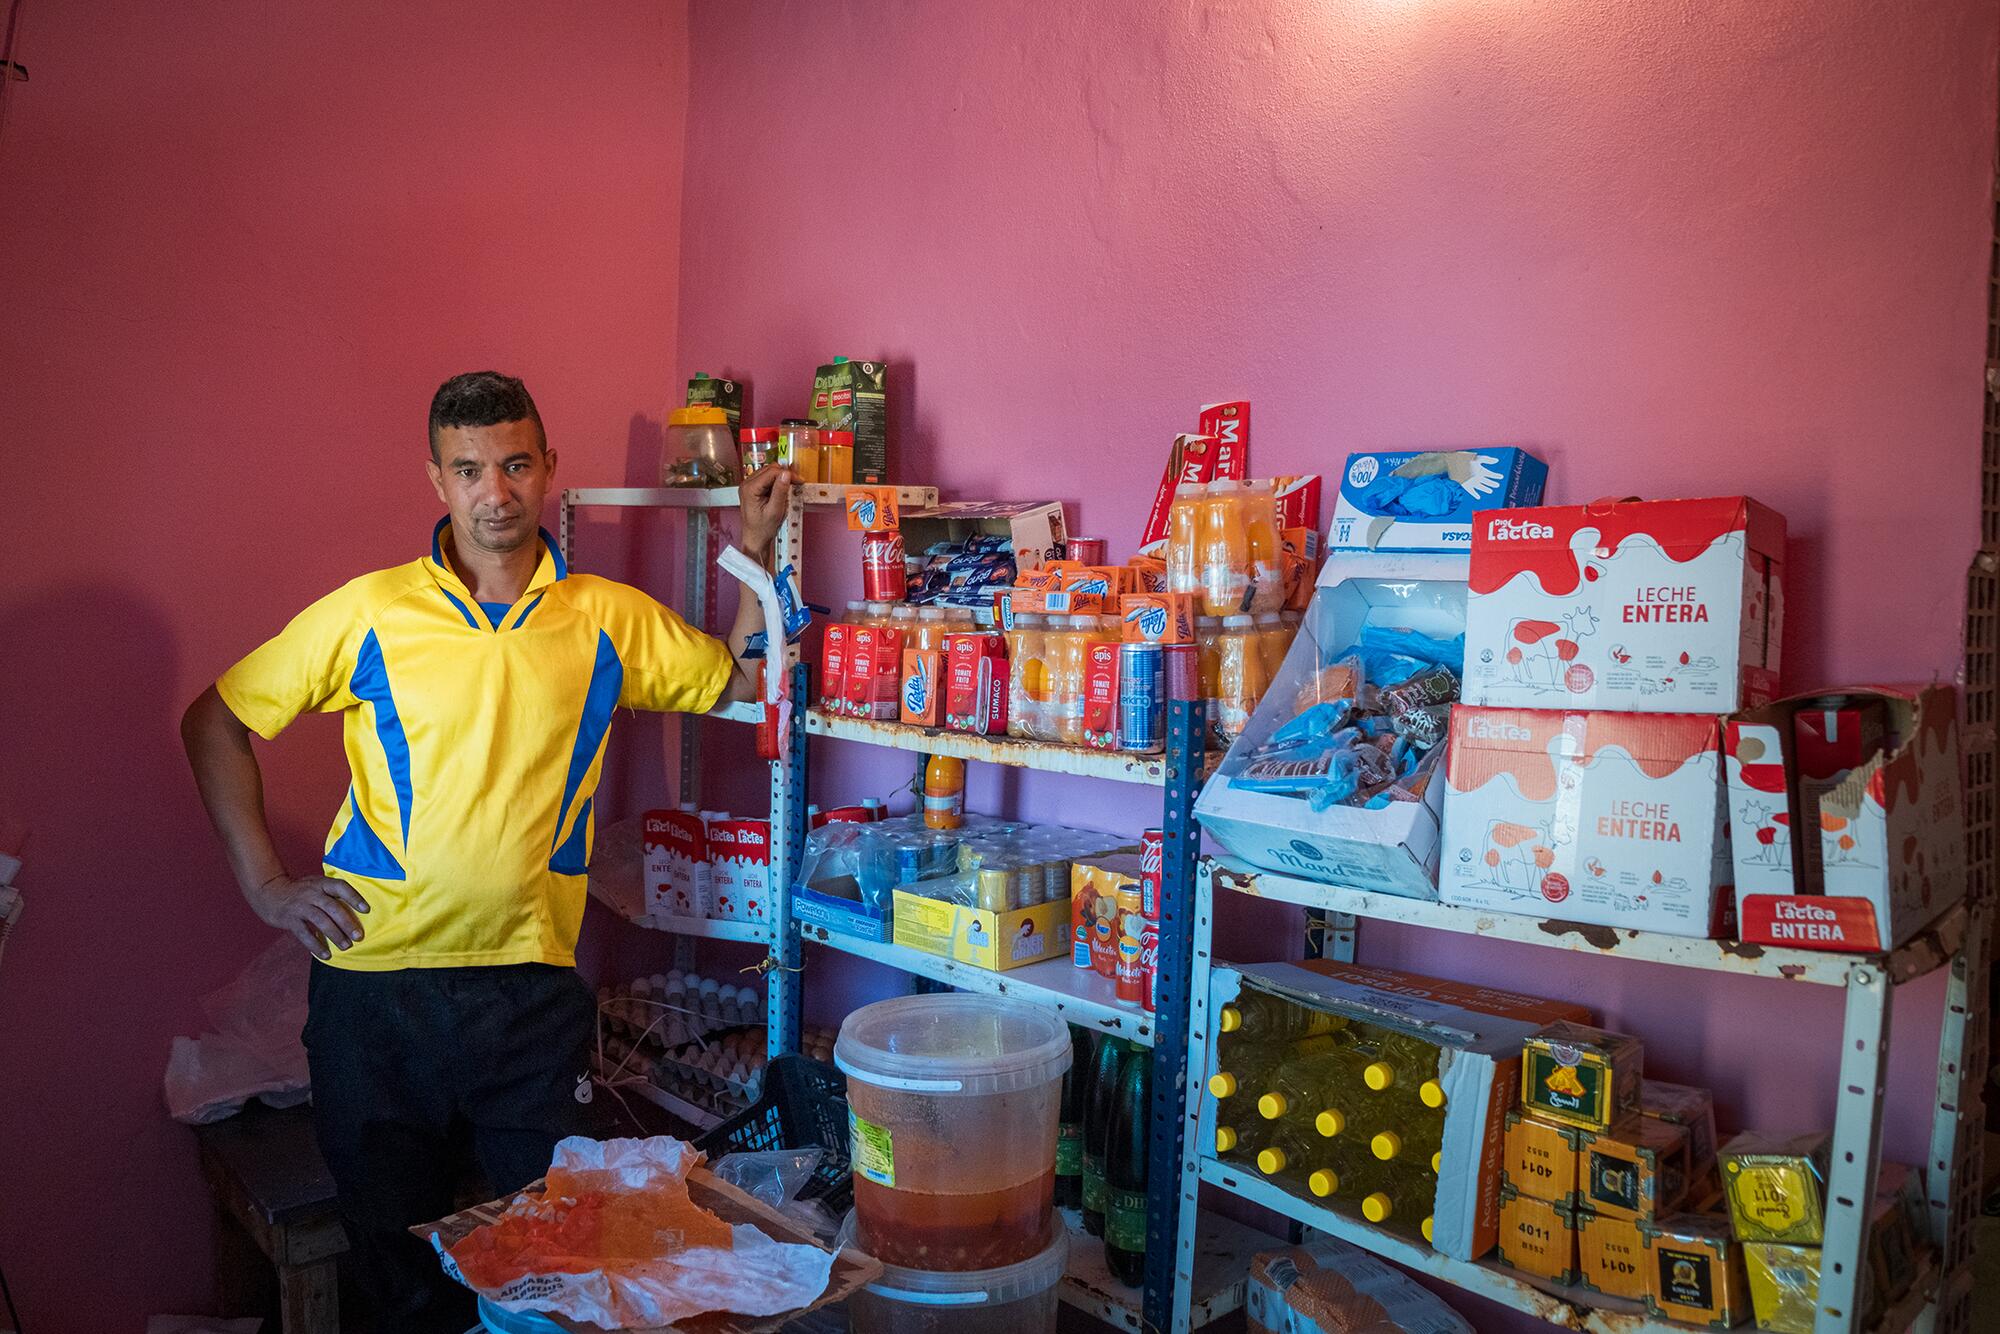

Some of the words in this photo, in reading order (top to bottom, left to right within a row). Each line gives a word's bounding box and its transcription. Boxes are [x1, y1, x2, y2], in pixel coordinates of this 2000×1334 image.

[1636, 586, 1697, 603] LECHE
[1622, 603, 1709, 624] ENTERA
[856, 632, 872, 645] apis
[955, 641, 975, 654] apis
[1093, 649, 1112, 663] apis
[991, 679, 1001, 720] SUMACO
[1610, 799, 1670, 820] LECHE
[1596, 816, 1682, 843] ENTERA
[1770, 922, 1846, 941] ENTERA
[1485, 1149, 1496, 1169] de
[1521, 1159, 1553, 1179] 4011
[1482, 1176, 1494, 1228] Aceite
[1518, 1222, 1551, 1242] 4011
[1601, 1257, 1636, 1275] 4011
